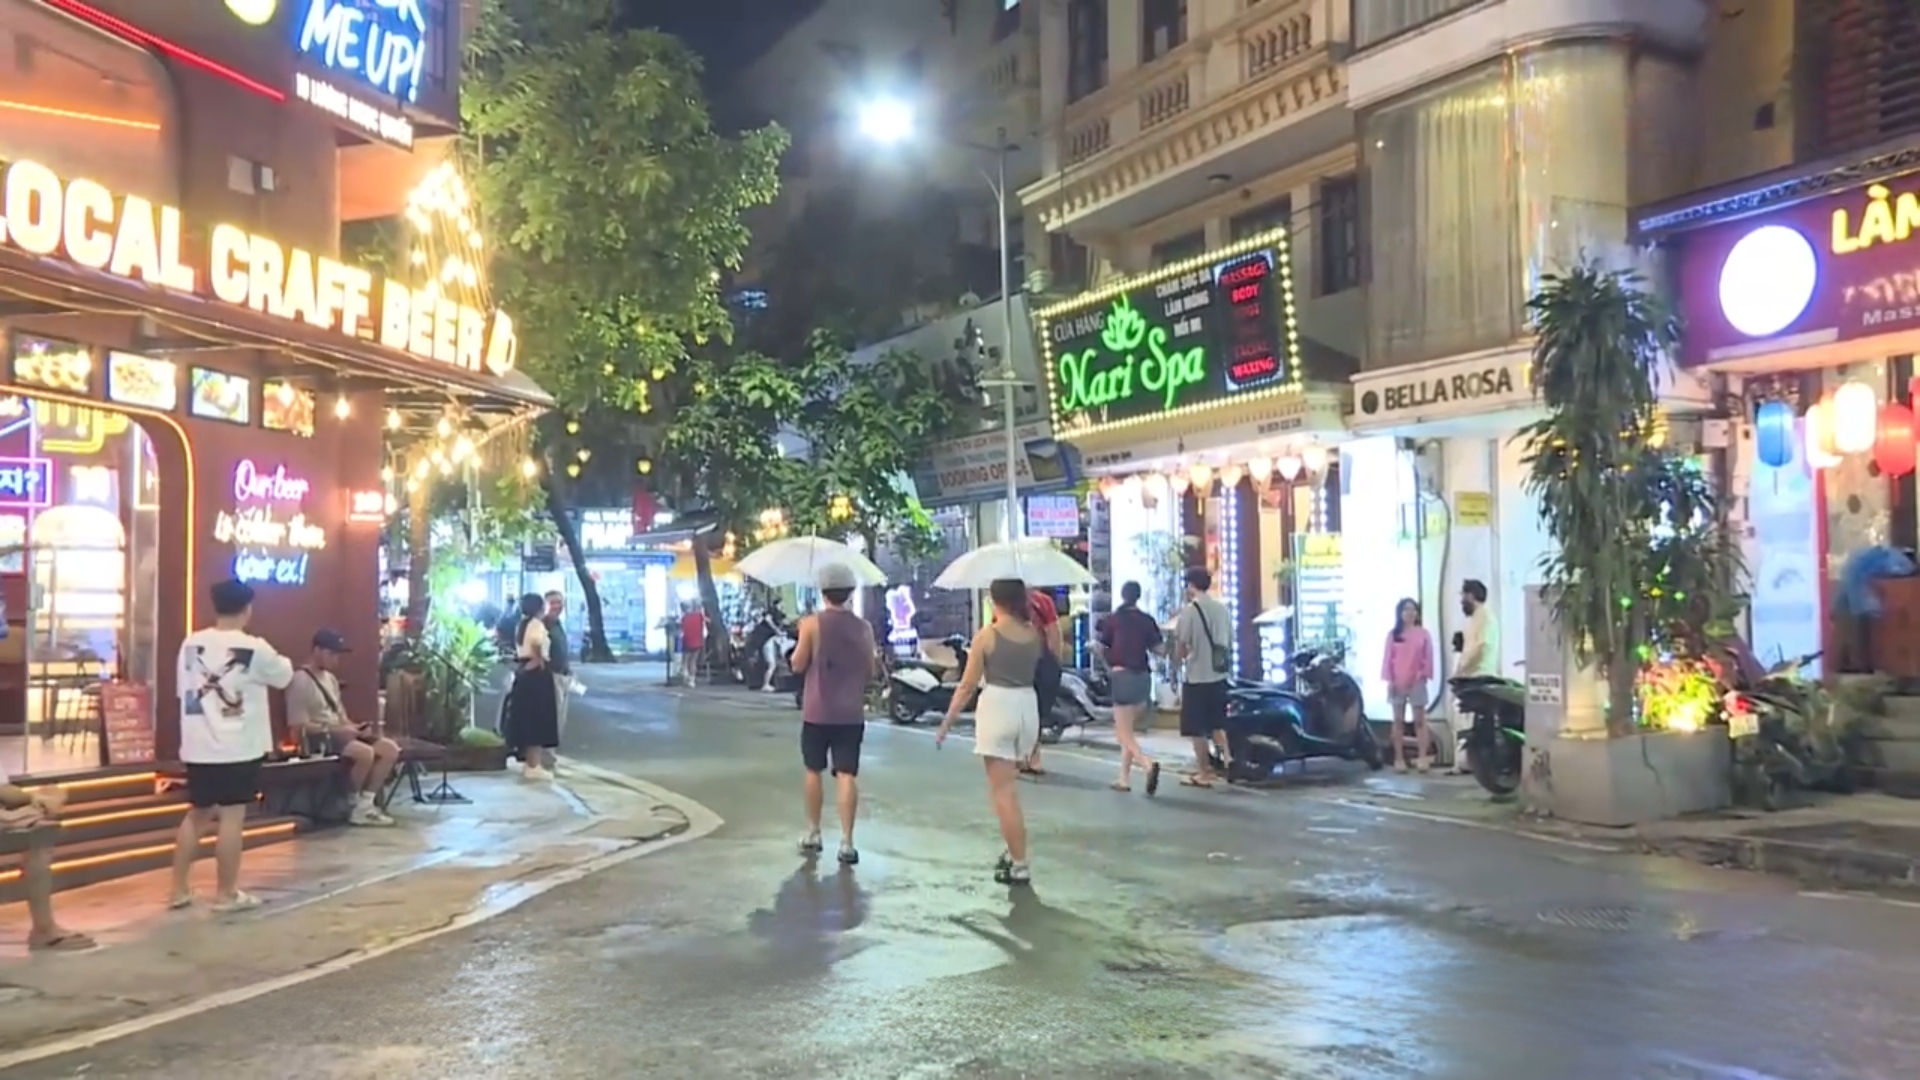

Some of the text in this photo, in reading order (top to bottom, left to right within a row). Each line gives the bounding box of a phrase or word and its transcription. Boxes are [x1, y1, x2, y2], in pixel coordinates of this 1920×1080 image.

[300, 0, 364, 68] ME
[365, 21, 426, 103] UP!
[0, 158, 195, 293] OCAL
[381, 277, 485, 372] BEER
[1219, 260, 1268, 285] MASSAGE
[1232, 283, 1260, 303] BODY
[1060, 327, 1204, 411] Nari Spa
[1231, 356, 1276, 379] WAXING
[1384, 378, 1449, 411] BELLA
[1452, 366, 1513, 400] ROSA
[990, 458, 1029, 482] OFCE
